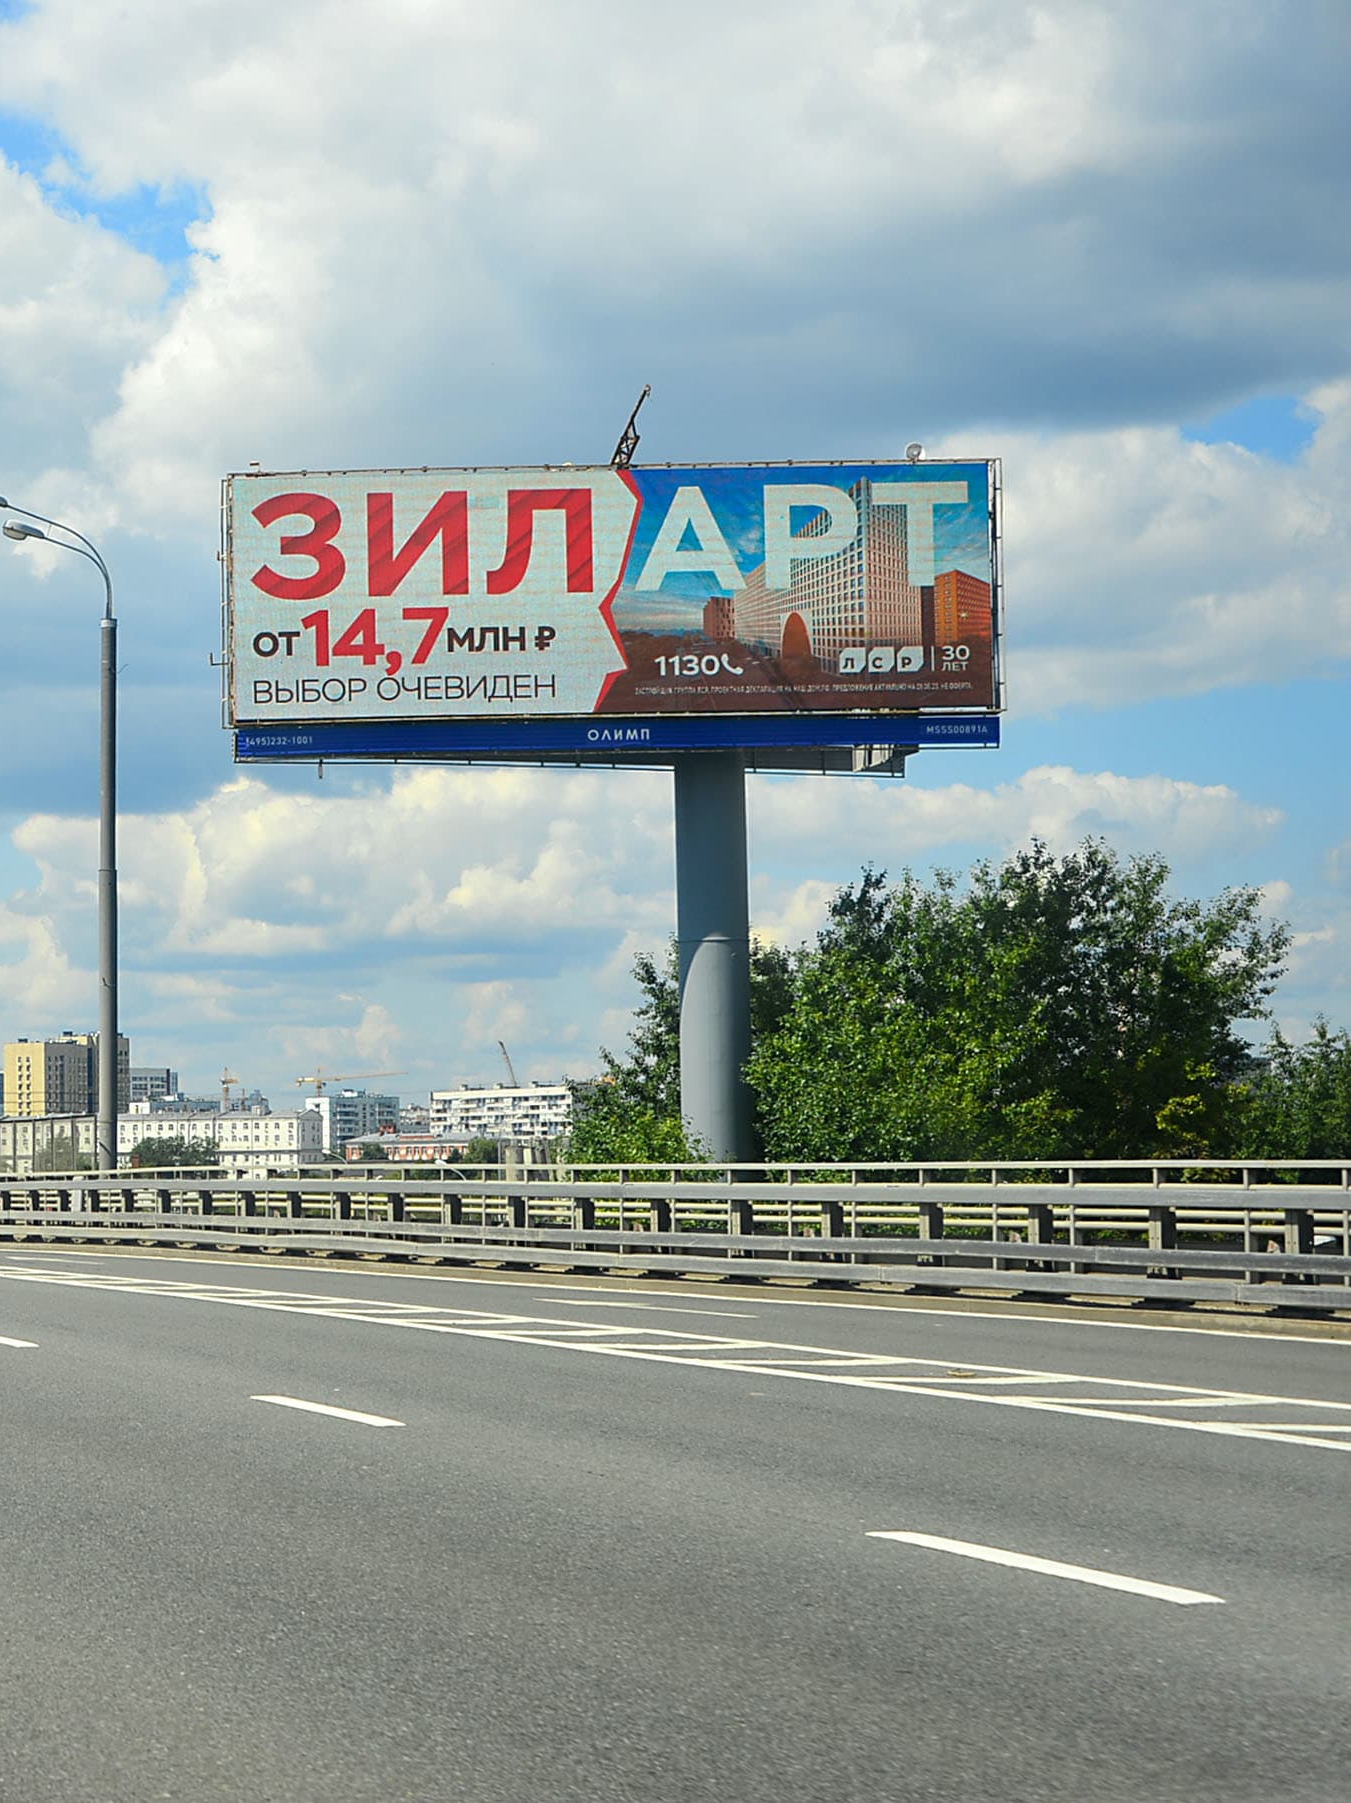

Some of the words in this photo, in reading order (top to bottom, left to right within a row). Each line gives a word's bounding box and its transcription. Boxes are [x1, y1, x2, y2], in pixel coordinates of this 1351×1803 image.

[253, 631, 301, 657] ОТ
[301, 606, 449, 676] 14,7
[447, 626, 526, 652] МЛН
[941, 645, 970, 660] 30
[654, 654, 720, 676] 1130
[941, 661, 969, 672] ЛЕТ
[253, 678, 367, 704] ВЫБОР
[376, 674, 556, 703] ОЧЕВИДЕН
[587, 728, 650, 741] ОЛИМП
